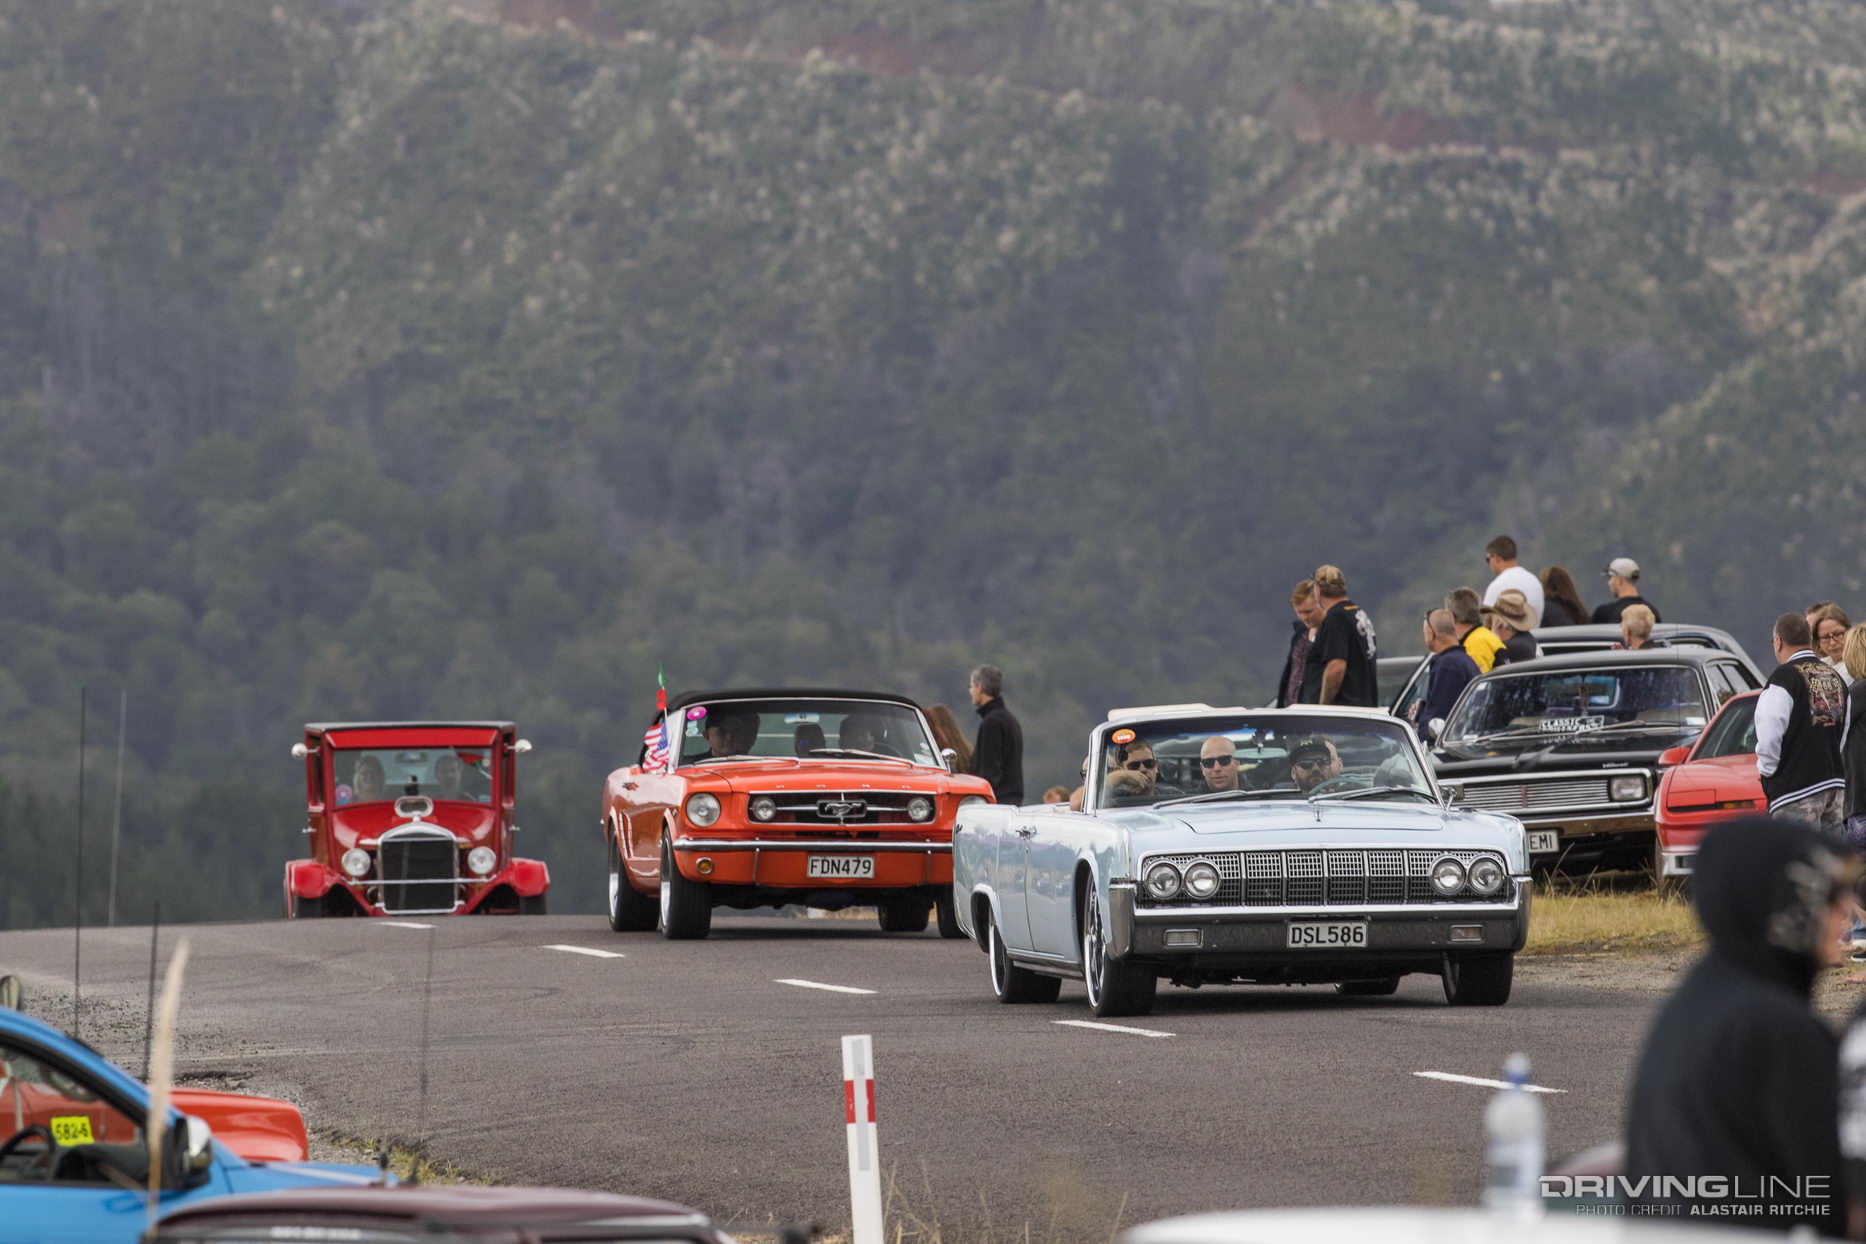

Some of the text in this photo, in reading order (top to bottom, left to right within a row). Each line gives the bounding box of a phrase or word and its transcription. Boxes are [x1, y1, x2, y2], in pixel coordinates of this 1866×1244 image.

[1542, 719, 1581, 727] CLASSIC
[810, 859, 872, 875] FDN479
[1291, 926, 1364, 944] DSL586
